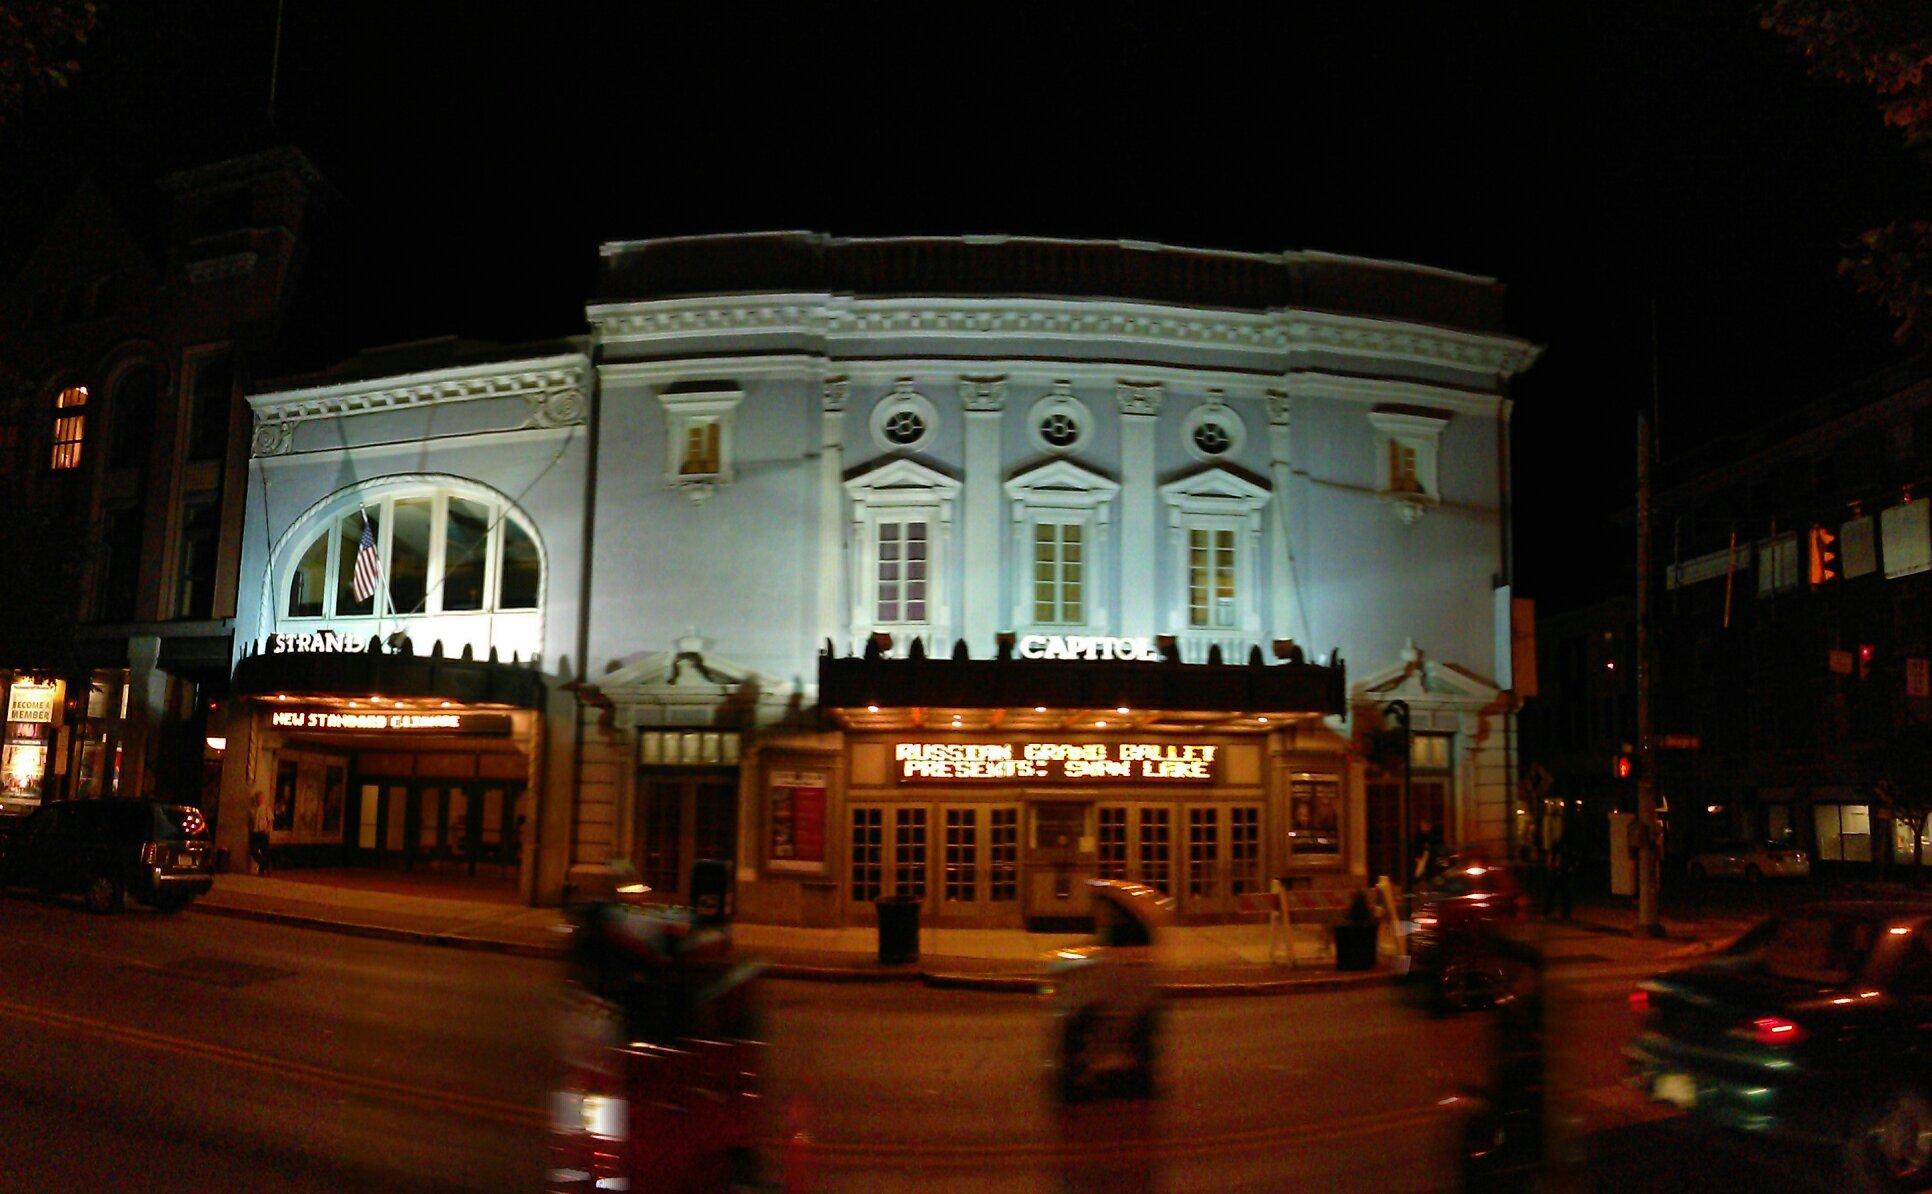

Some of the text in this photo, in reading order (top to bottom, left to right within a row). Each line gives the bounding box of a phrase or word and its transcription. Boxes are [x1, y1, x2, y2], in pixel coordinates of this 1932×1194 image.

[273, 632, 366, 654] STRAND
[1019, 635, 1158, 662] CAPITOL
[12, 701, 45, 709] BECOME
[11, 710, 50, 720] MEMBER
[273, 712, 305, 727] NEW
[895, 743, 1217, 762] RUSSIAN GRAND BALLET
[1063, 760, 1132, 778] SWAN
[1141, 760, 1212, 779] LAKE
